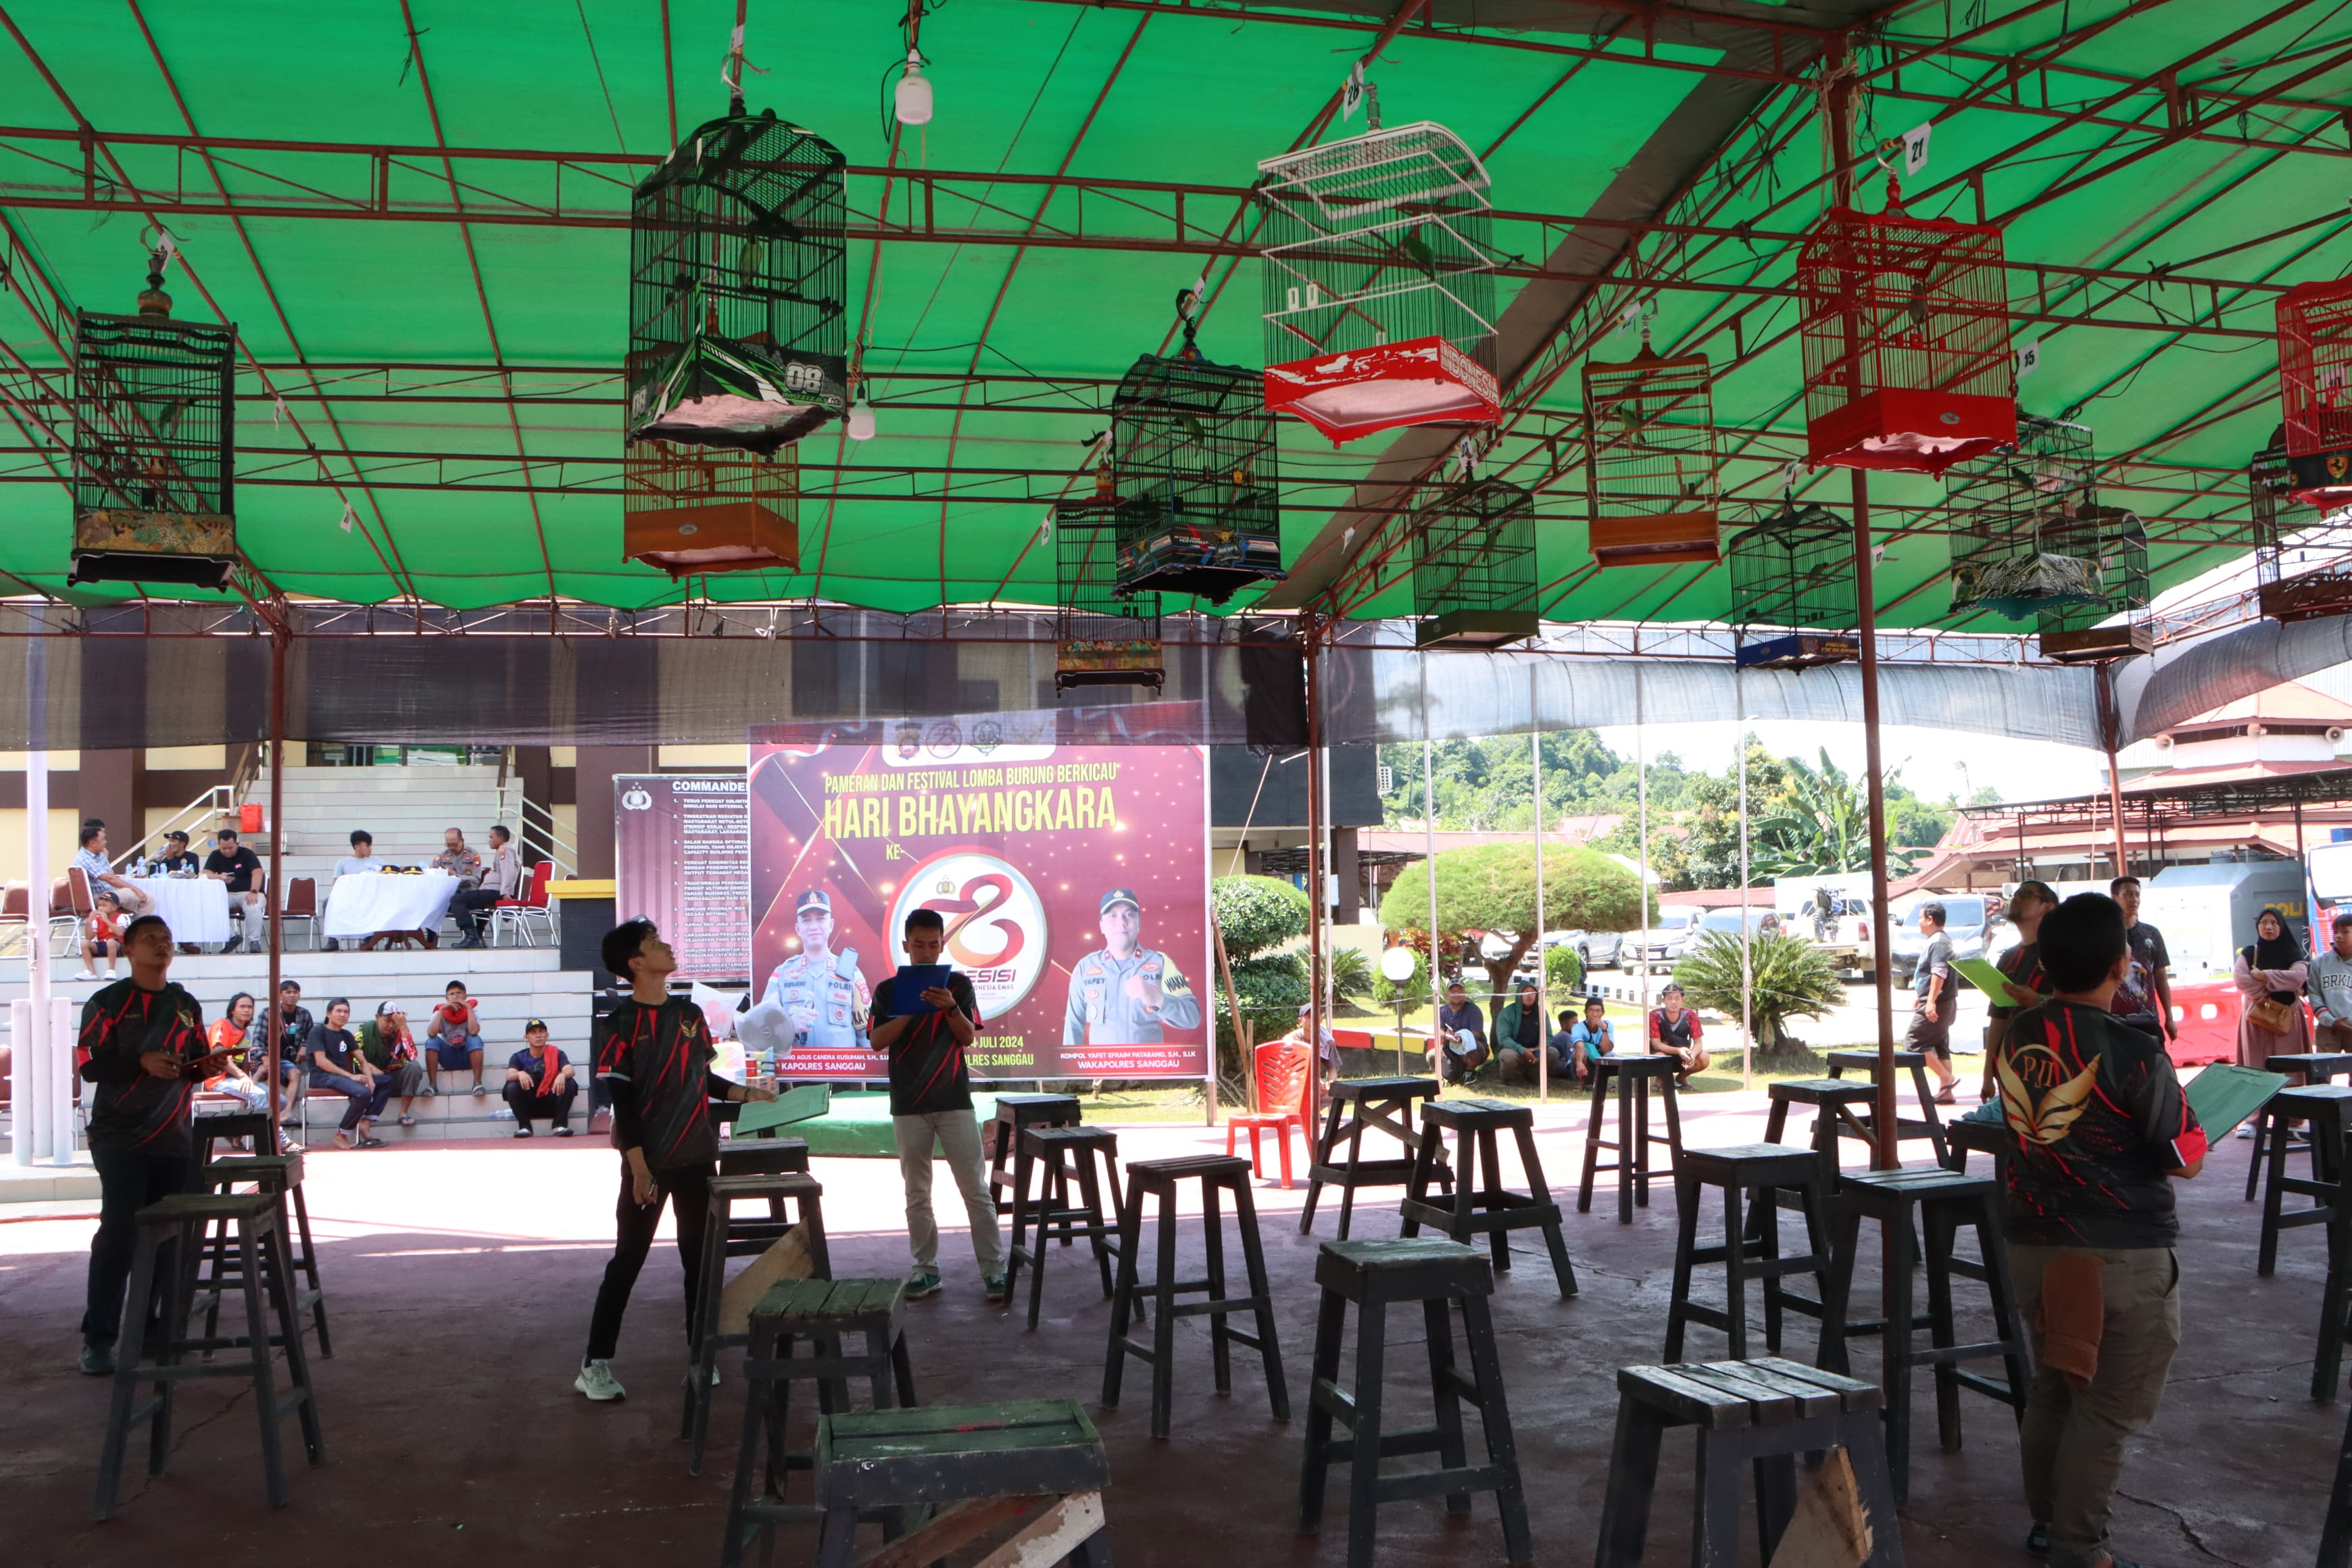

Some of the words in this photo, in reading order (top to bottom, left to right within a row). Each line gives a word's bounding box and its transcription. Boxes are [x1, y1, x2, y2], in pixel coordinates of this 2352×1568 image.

[1911, 137, 1924, 163] 21
[2024, 350, 2034, 368] 15
[785, 362, 825, 394] 08
[1440, 339, 1500, 409] INDONESIA
[825, 774, 878, 793] PAMERAN
[881, 773, 904, 791] DAN
[908, 770, 960, 790] FESTIVAL
[963, 768, 1003, 787] LOMBA
[1006, 765, 1054, 785] BURUNG
[1057, 762, 1117, 783] BERKICAU
[825, 798, 889, 839] HARI
[899, 787, 1117, 837] BHAYANGKARA
[886, 844, 905, 860] KE-
[963, 969, 1016, 983] ESISI
[828, 982, 851, 991] POLRI
[979, 1036, 997, 1048] JULI
[1000, 1035, 1024, 1048] 2024
[825, 1062, 866, 1071] SANGGAU
[991, 1054, 1034, 1065] SANGGAU
[1077, 1060, 1134, 1069] WAKAPOLRES
[1137, 1060, 1180, 1068] SANGGAU
